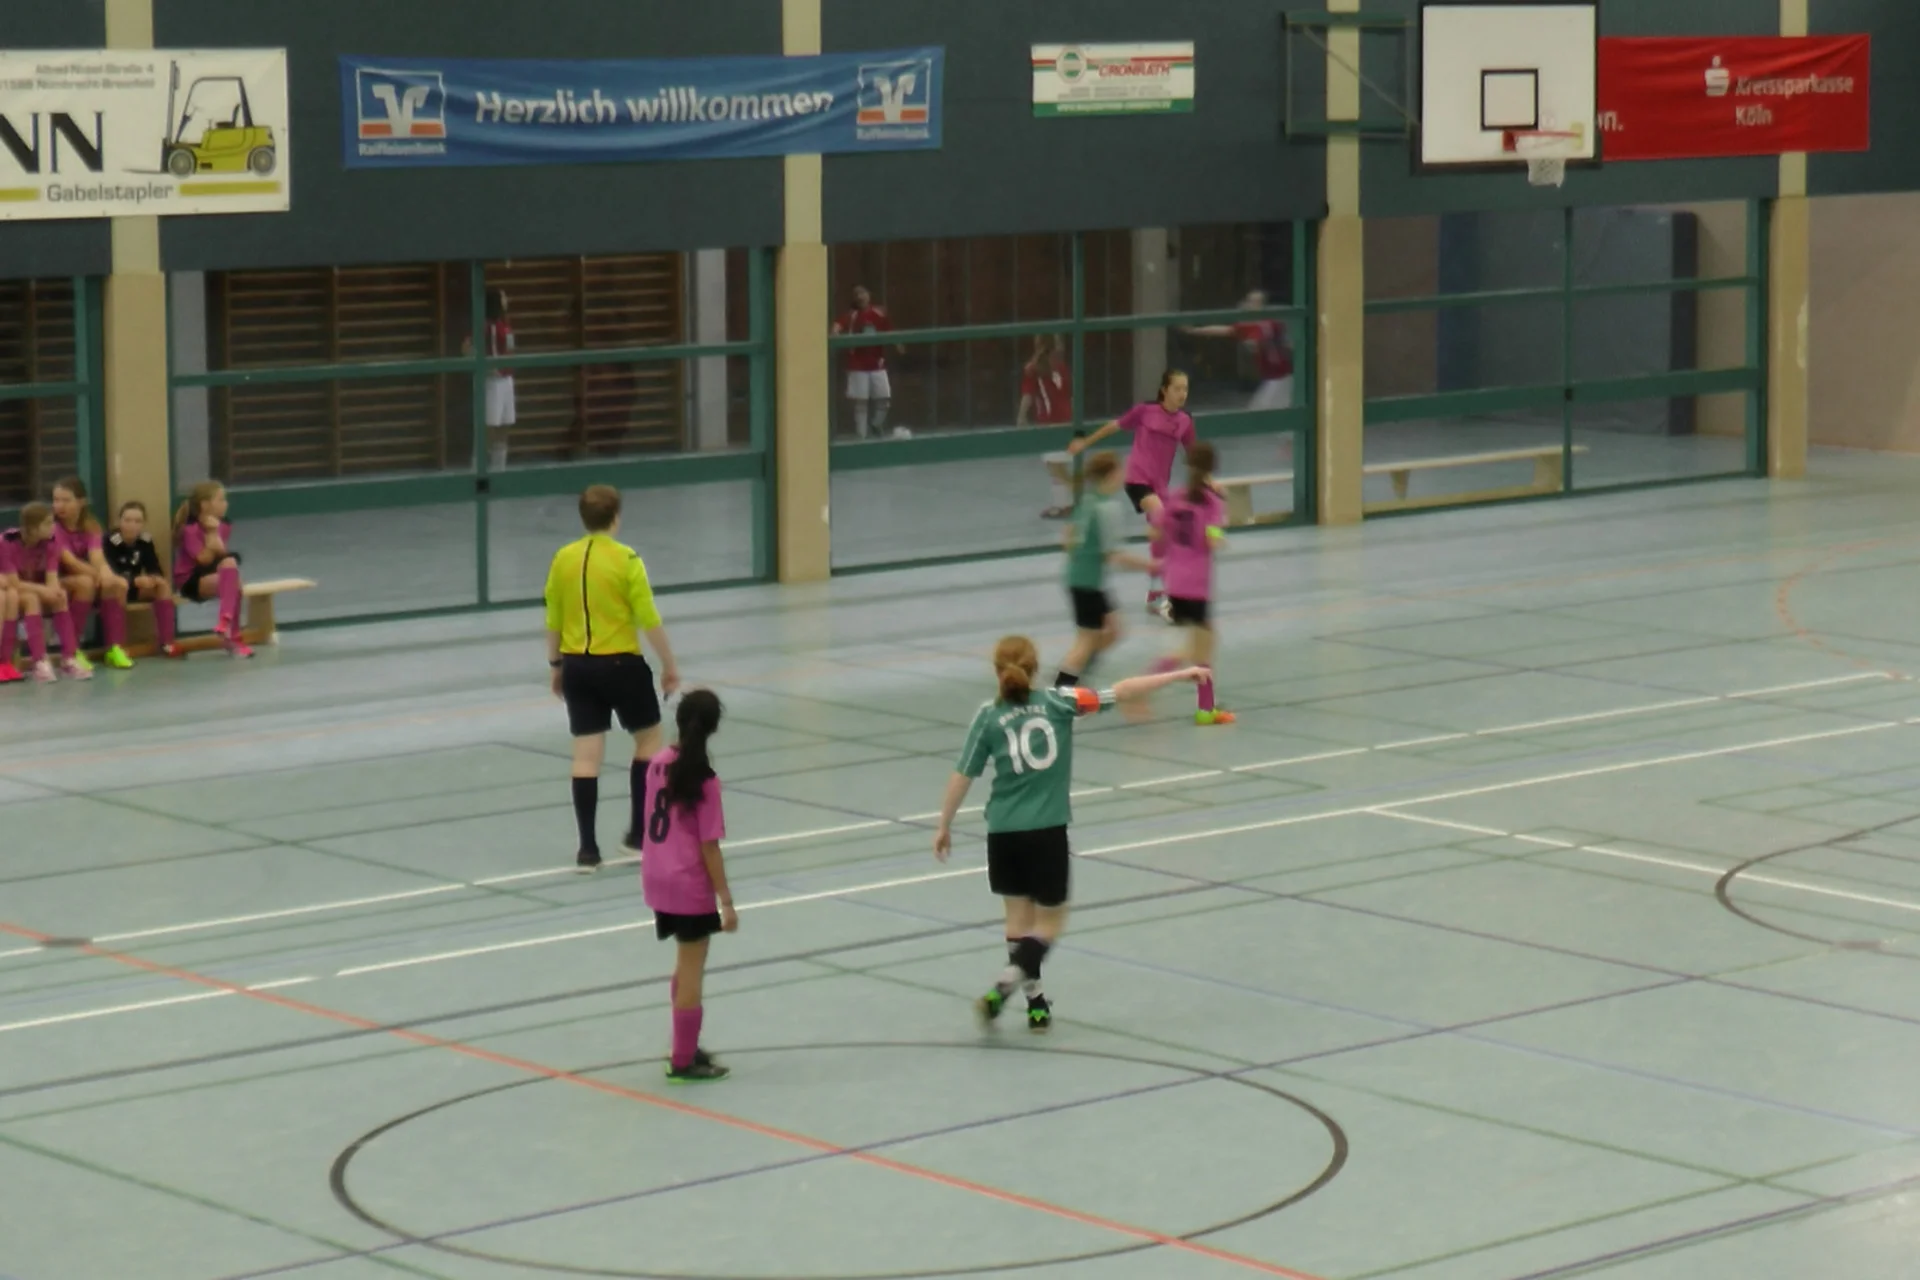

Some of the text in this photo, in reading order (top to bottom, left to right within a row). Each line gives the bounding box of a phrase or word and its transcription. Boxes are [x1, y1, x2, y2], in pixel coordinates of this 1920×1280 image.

[1735, 73, 1853, 98] Kreissparkasse
[475, 86, 834, 123] Herzlich willkommen
[1735, 104, 1773, 126] Köln
[47, 182, 174, 205] Gabelstapler
[1004, 717, 1057, 775] 10
[648, 787, 671, 844] 8
